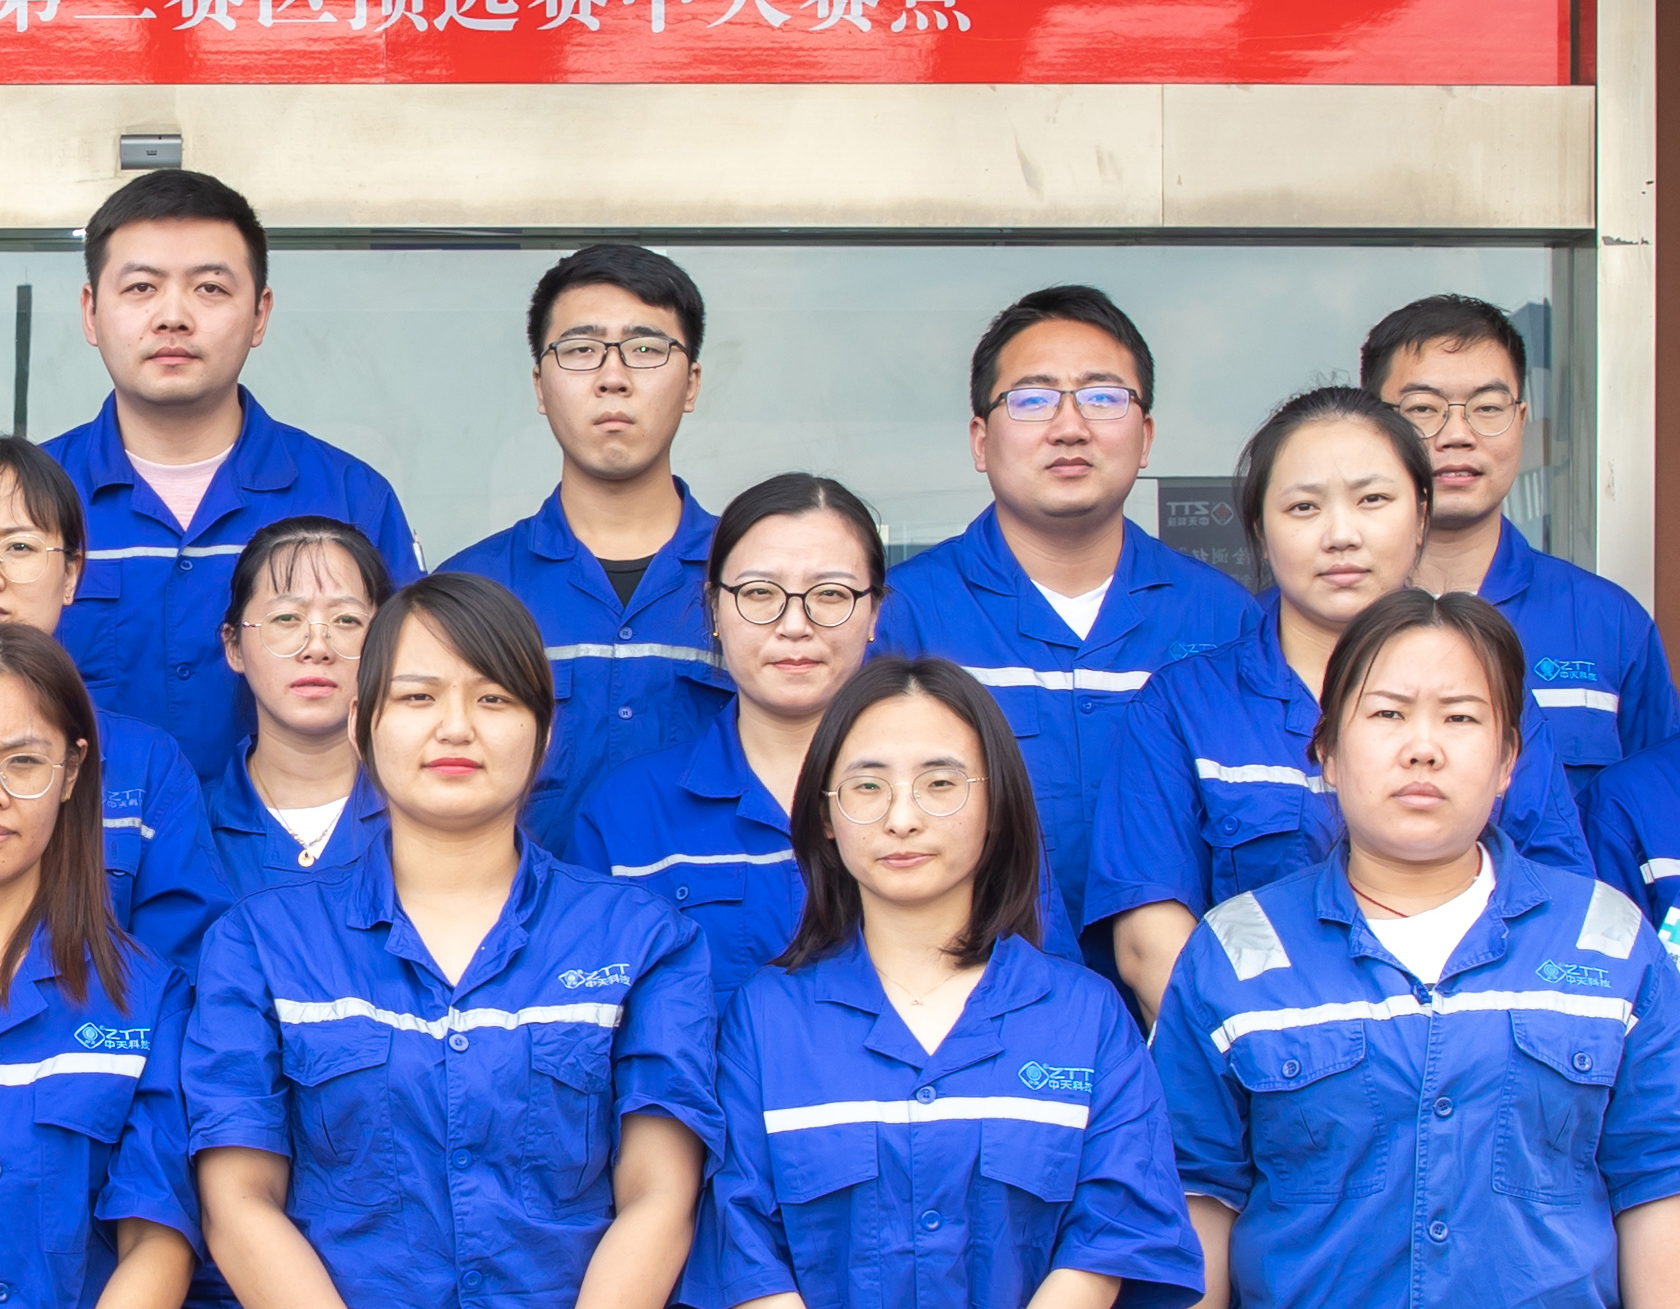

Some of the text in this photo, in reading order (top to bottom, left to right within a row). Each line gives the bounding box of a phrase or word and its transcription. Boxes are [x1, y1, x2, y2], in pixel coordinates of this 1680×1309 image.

[1561, 660, 1595, 670] ZTT
[585, 963, 630, 980] ZTT
[1566, 965, 1609, 979] ZTT
[105, 1027, 151, 1040] ZTT
[1048, 1067, 1095, 1080] ZTT
